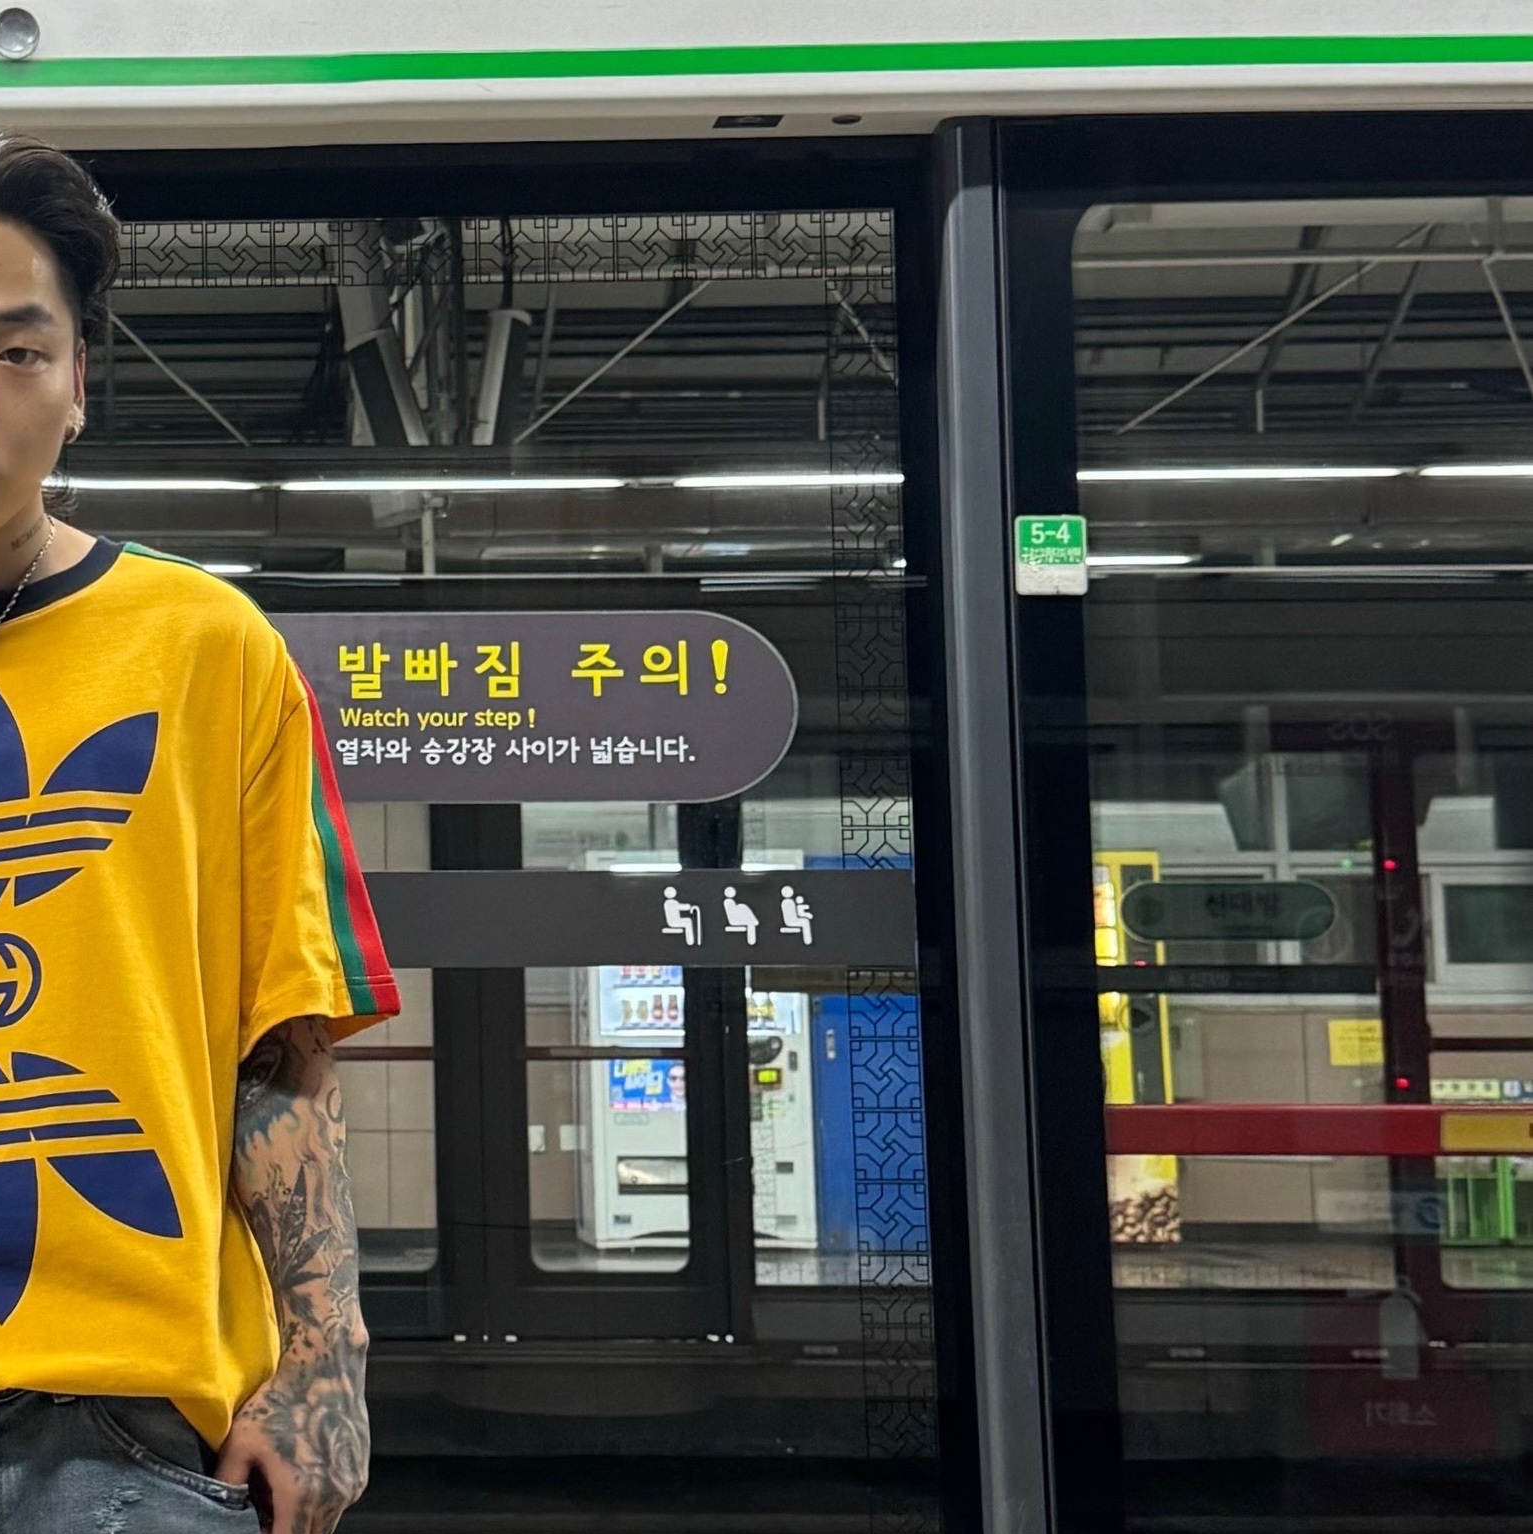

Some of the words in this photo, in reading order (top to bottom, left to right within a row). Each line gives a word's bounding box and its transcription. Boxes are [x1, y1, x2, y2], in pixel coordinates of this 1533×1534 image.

[1031, 522, 1071, 544] 5-4
[338, 641, 521, 699] 발빠짐
[339, 708, 410, 728] Watch
[417, 711, 468, 731] your
[474, 710, 523, 730] step
[335, 737, 412, 766] 열차와
[419, 736, 497, 766] 승강장
[505, 735, 581, 764] 사이가
[590, 734, 696, 765] 넓습니다.
